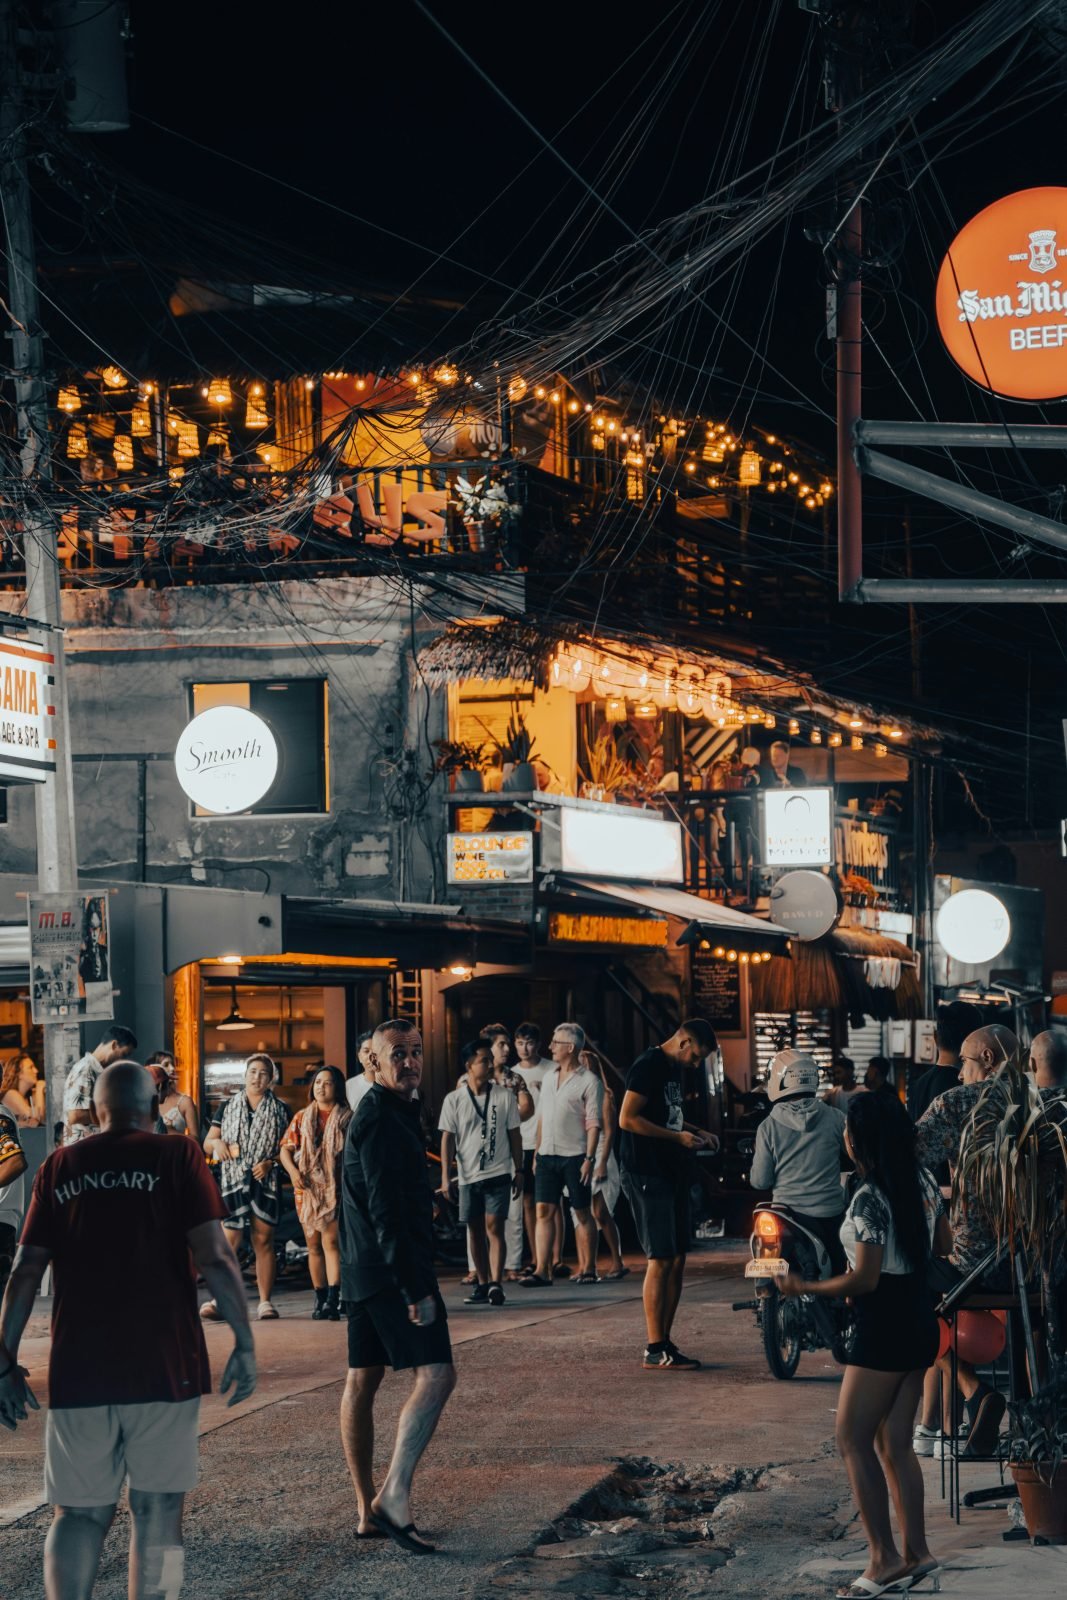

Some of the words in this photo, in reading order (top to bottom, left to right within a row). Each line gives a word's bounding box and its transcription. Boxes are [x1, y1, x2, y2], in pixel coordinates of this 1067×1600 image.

[957, 288, 1014, 322] San
[0, 666, 39, 716] AMA
[0, 721, 16, 744] AGE
[17, 727, 24, 745] &
[24, 725, 40, 749] SPA
[185, 739, 263, 773] Smooth
[54, 1171, 160, 1205] HUNGARY
